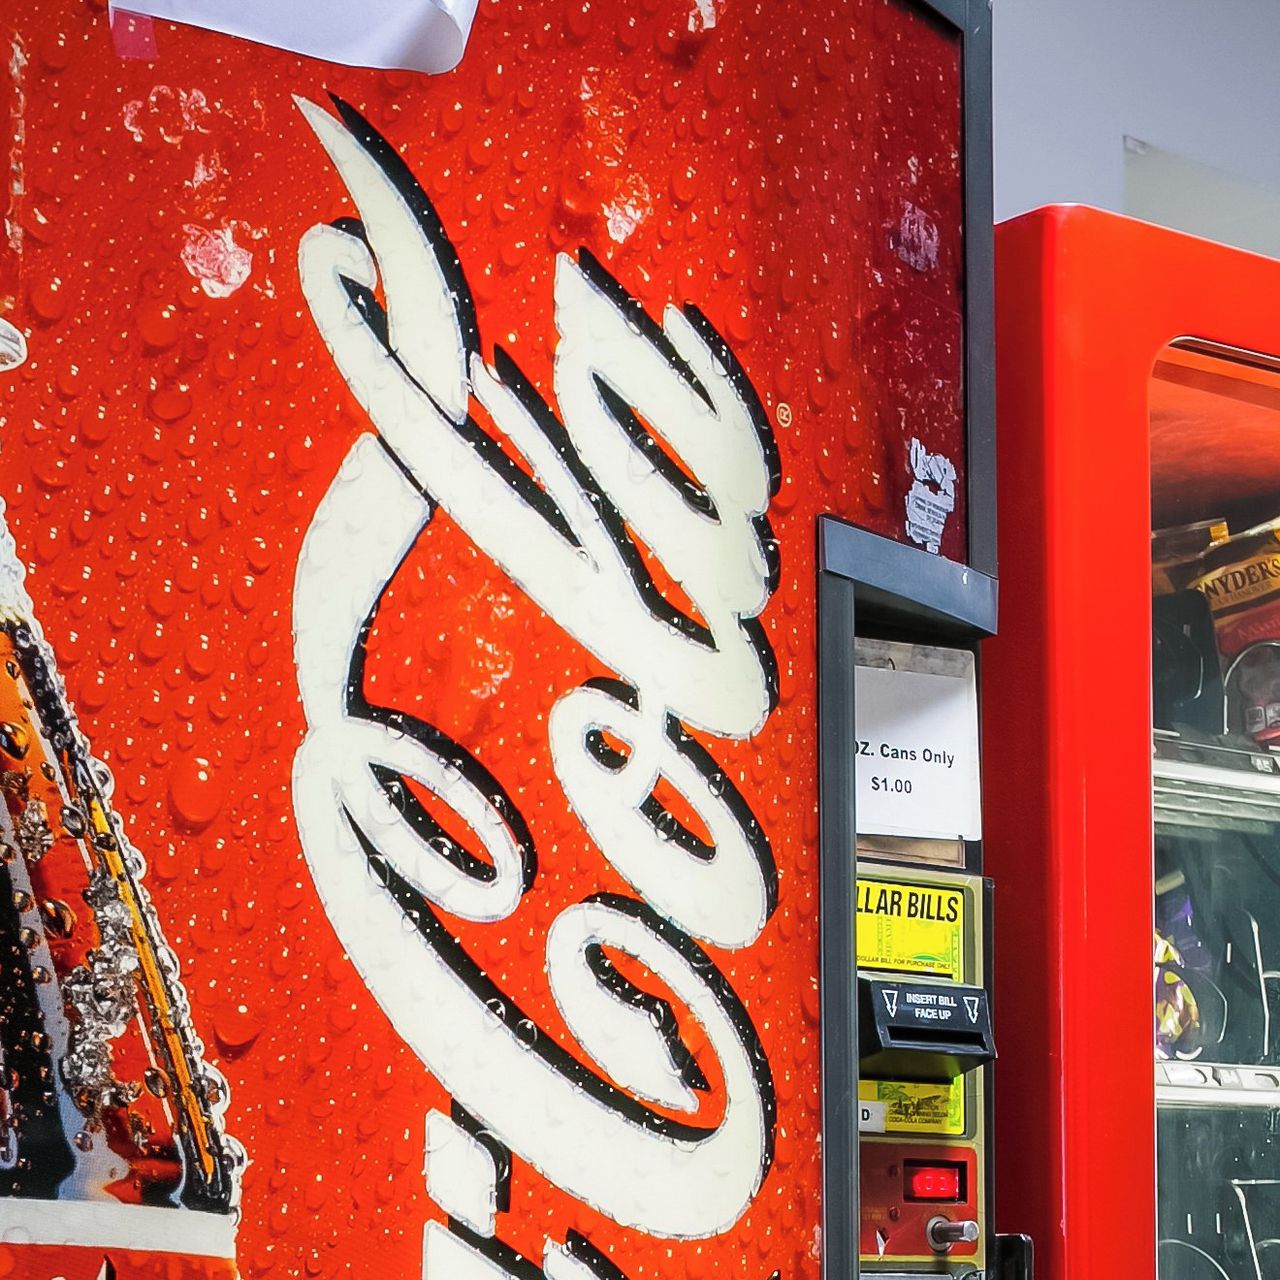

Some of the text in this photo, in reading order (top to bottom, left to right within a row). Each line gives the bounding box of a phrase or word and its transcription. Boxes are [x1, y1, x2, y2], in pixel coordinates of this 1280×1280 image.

[880, 743, 917, 761] Cans
[922, 748, 955, 769] Only
[871, 776, 913, 794] $1.00
[907, 891, 959, 923] BILLS
[906, 992, 957, 1007] INSERT BILL
[914, 1007, 952, 1020] FACE UP
[861, 1108, 870, 1121] D
